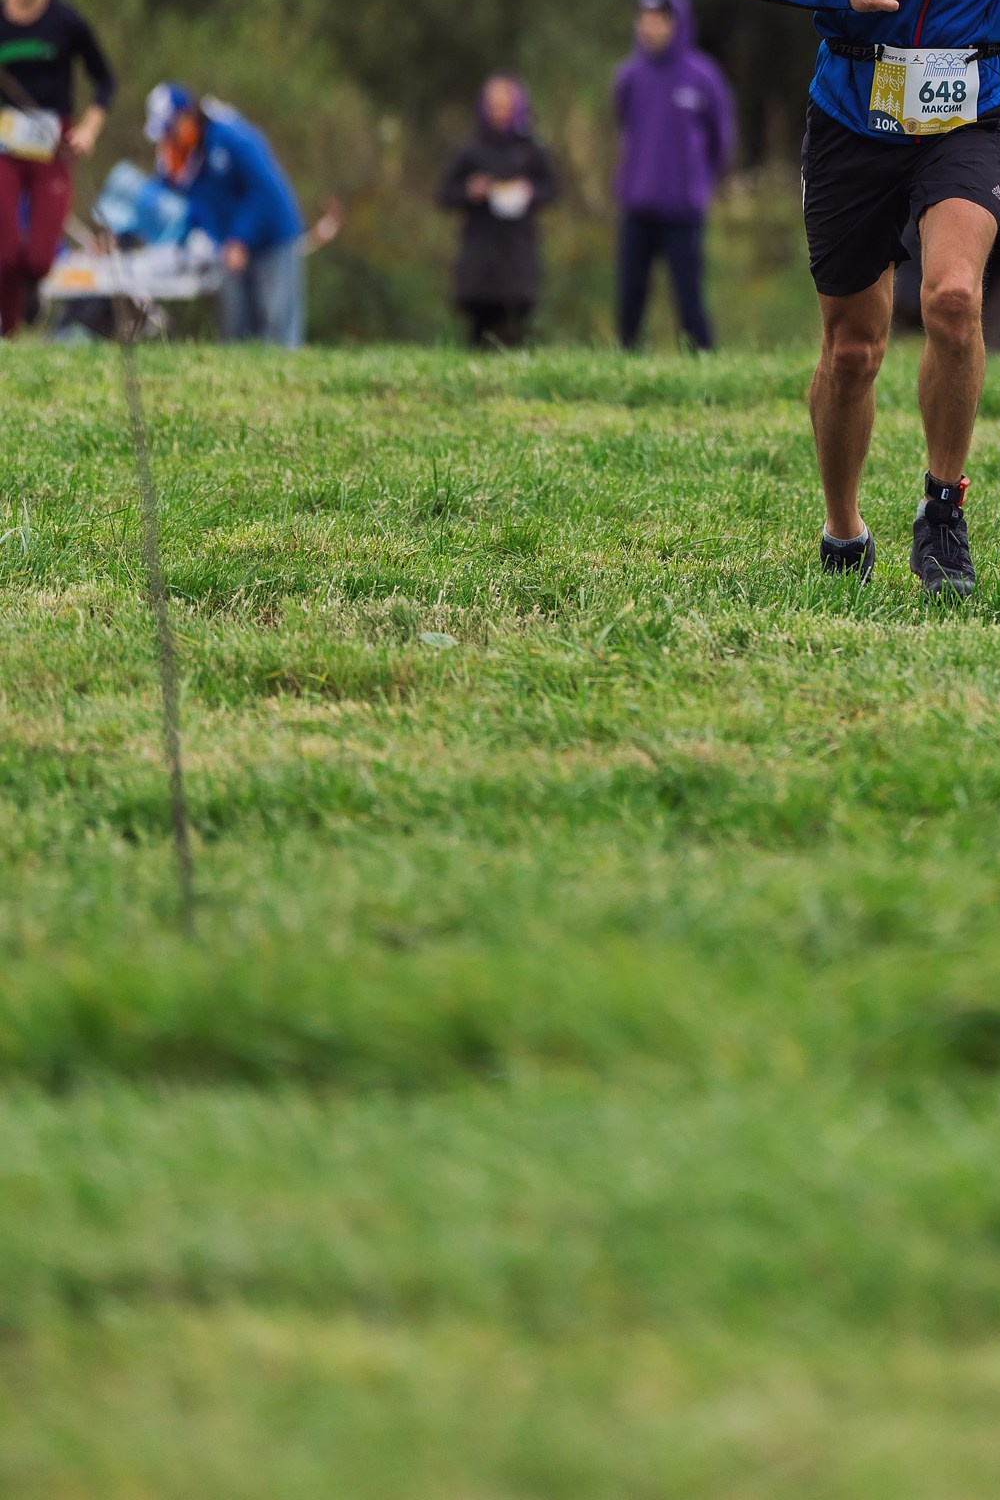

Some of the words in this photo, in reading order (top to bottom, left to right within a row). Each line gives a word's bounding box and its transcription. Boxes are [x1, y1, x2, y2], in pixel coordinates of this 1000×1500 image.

[919, 80, 967, 103] 648
[921, 104, 962, 114] МАКСИМ
[875, 117, 898, 132] 10K
